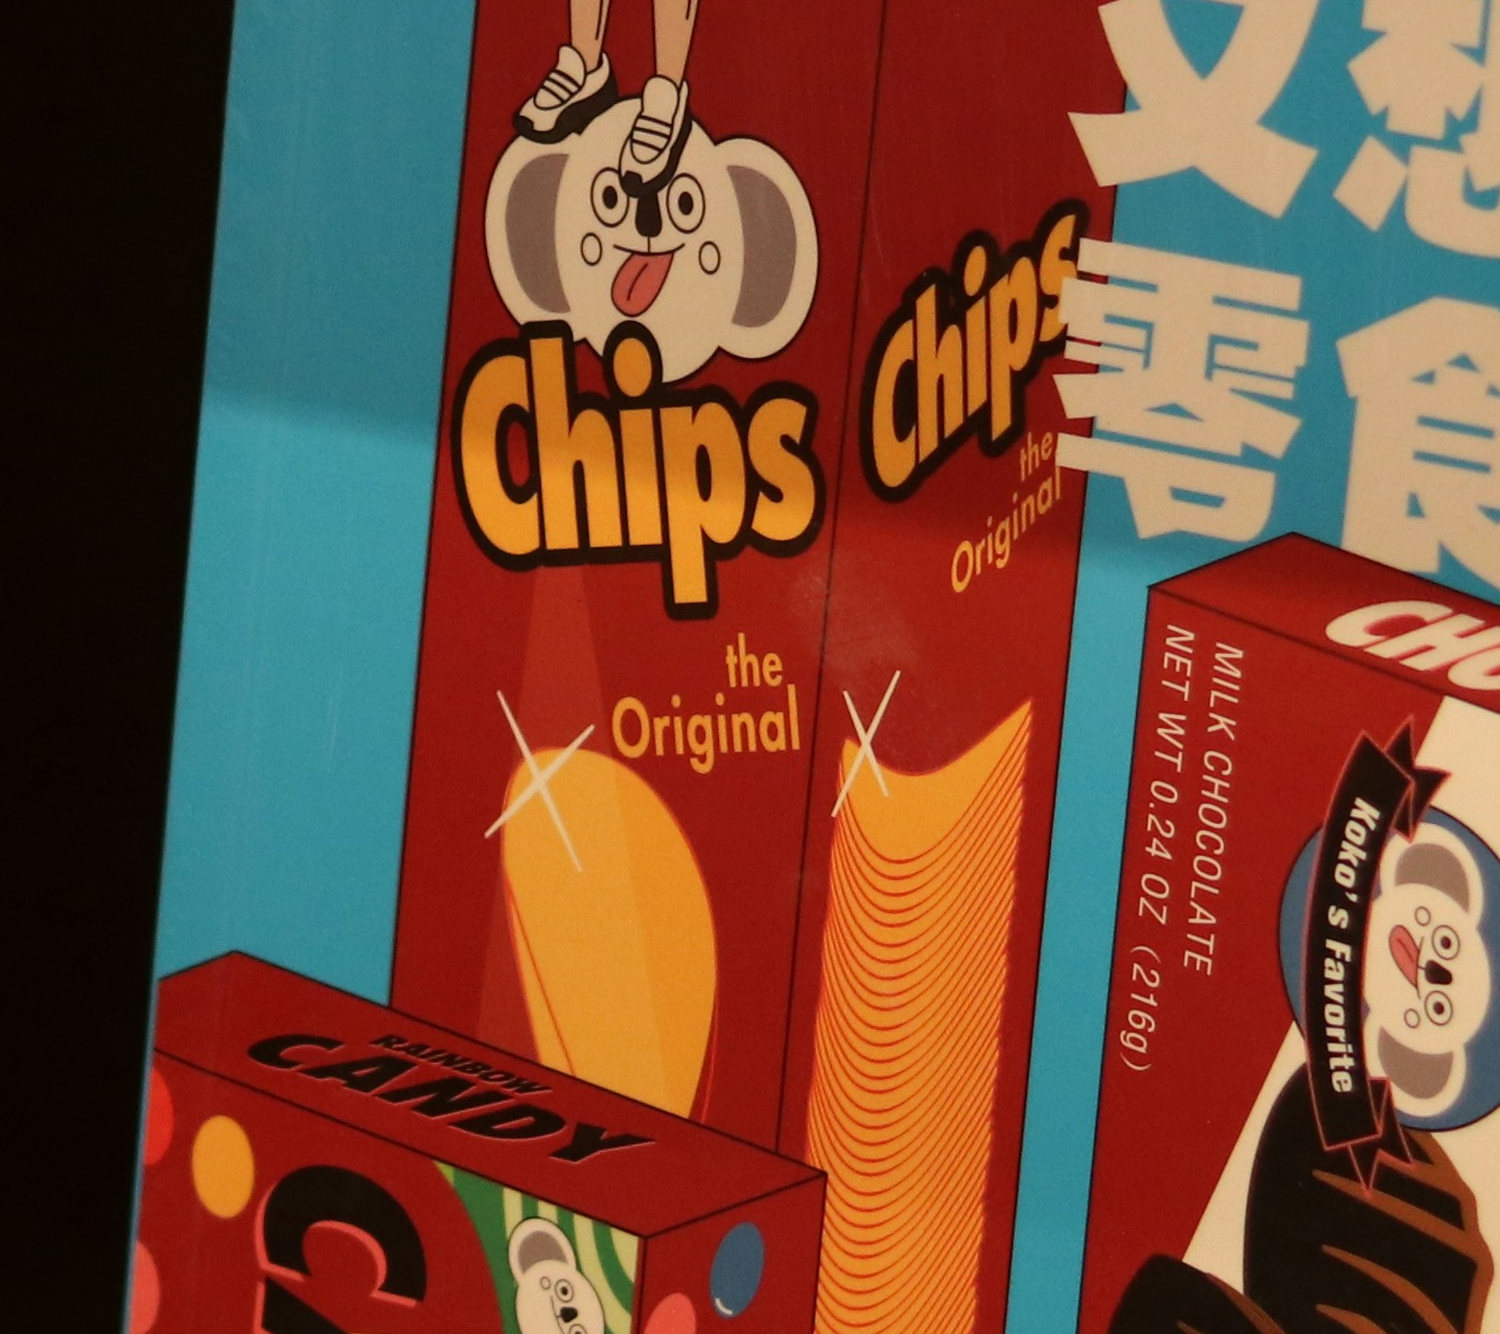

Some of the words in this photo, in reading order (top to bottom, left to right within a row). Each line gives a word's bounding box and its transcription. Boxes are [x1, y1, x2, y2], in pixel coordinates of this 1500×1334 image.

[863, 201, 1089, 502] Chips
[453, 322, 826, 618] Chips
[1018, 431, 1055, 483] the
[951, 449, 1061, 593] Original
[724, 633, 784, 690] the
[1162, 624, 1195, 701] NET
[1207, 641, 1244, 740] MILK
[611, 686, 800, 775] Original
[1154, 713, 1187, 773] WT
[1145, 779, 1179, 861] 0.24
[1183, 749, 1233, 976] CHOCOLATE
[1138, 873, 1170, 925] OZ
[1120, 945, 1161, 1072] (216g)
[1324, 939, 1355, 1094] Favorite
[246, 1032, 655, 1163] CANDY
[370, 1033, 553, 1097] RAINBOW
